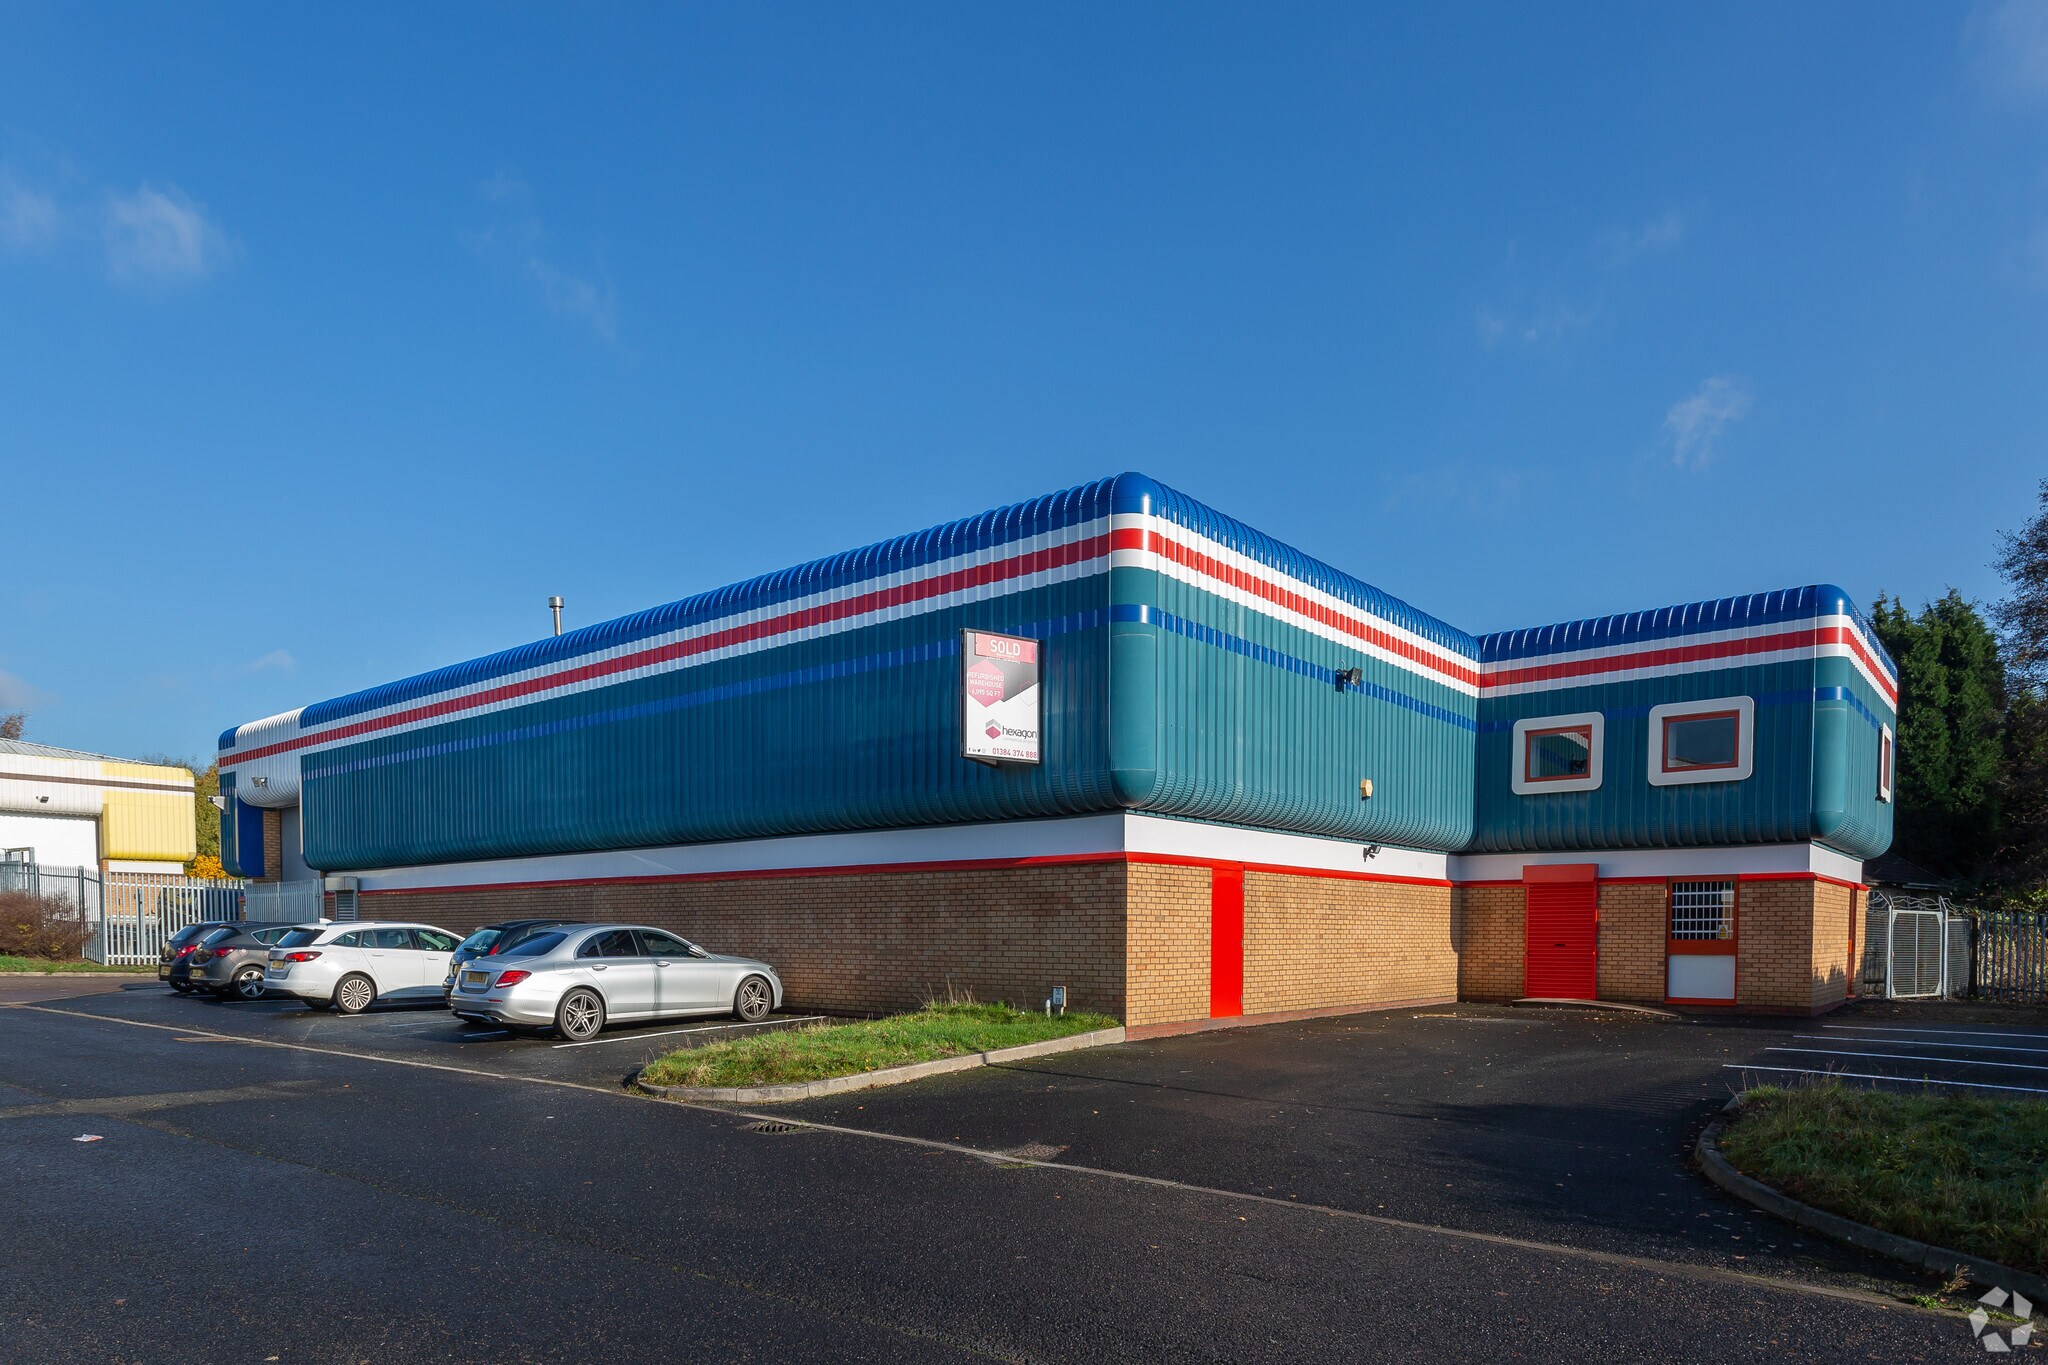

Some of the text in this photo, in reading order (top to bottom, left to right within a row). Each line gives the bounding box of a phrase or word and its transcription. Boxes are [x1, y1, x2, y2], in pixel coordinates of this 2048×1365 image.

[990, 639, 1021, 656] SOLD
[969, 679, 1003, 689] WAREHOUSE
[985, 689, 994, 697] SQ
[1002, 725, 1038, 739] hexagon
[992, 747, 1011, 756] 01384
[1012, 749, 1024, 758] 374
